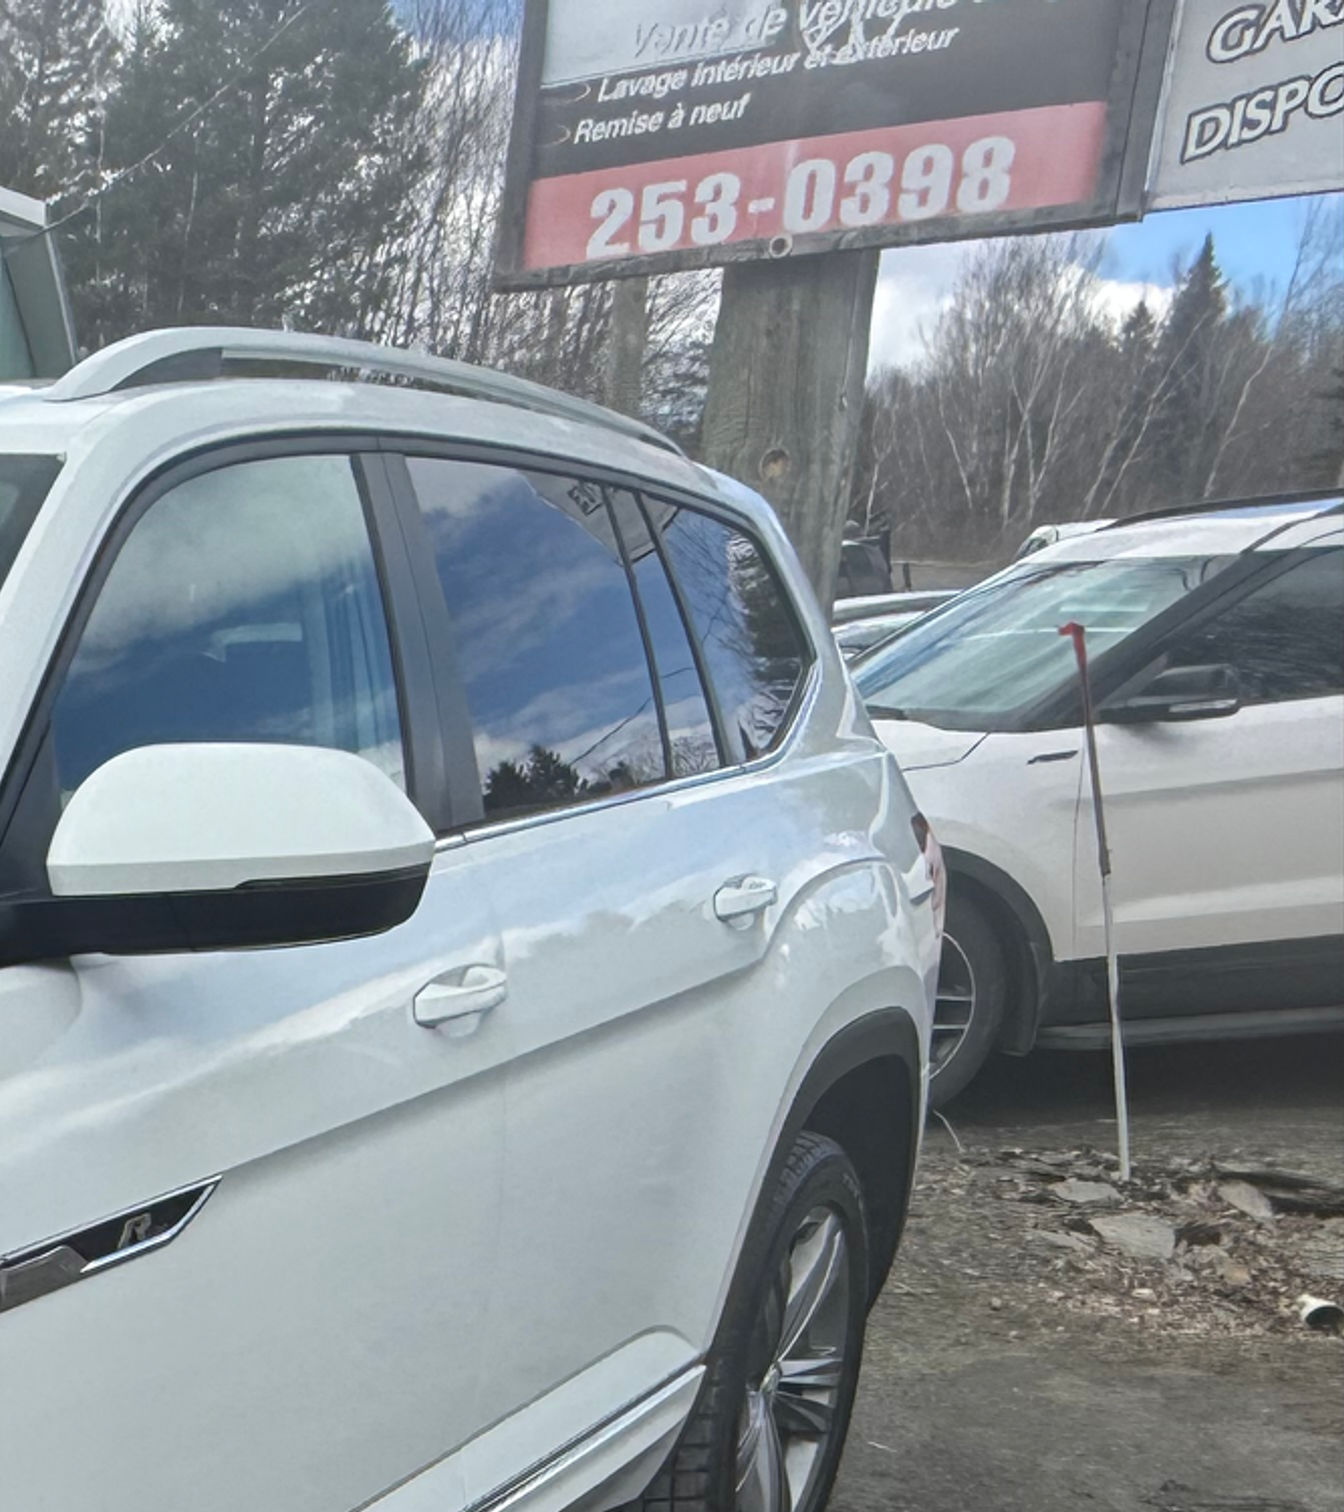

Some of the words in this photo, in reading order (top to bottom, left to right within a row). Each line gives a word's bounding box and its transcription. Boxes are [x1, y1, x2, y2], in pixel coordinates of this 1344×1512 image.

[745, 5, 788, 40] de
[597, 69, 688, 103] Lavage
[691, 51, 802, 87] intérieur
[573, 108, 666, 144] Remise
[667, 101, 685, 130] à
[689, 92, 751, 127] neuf
[584, 135, 1017, 260] 253-0398
